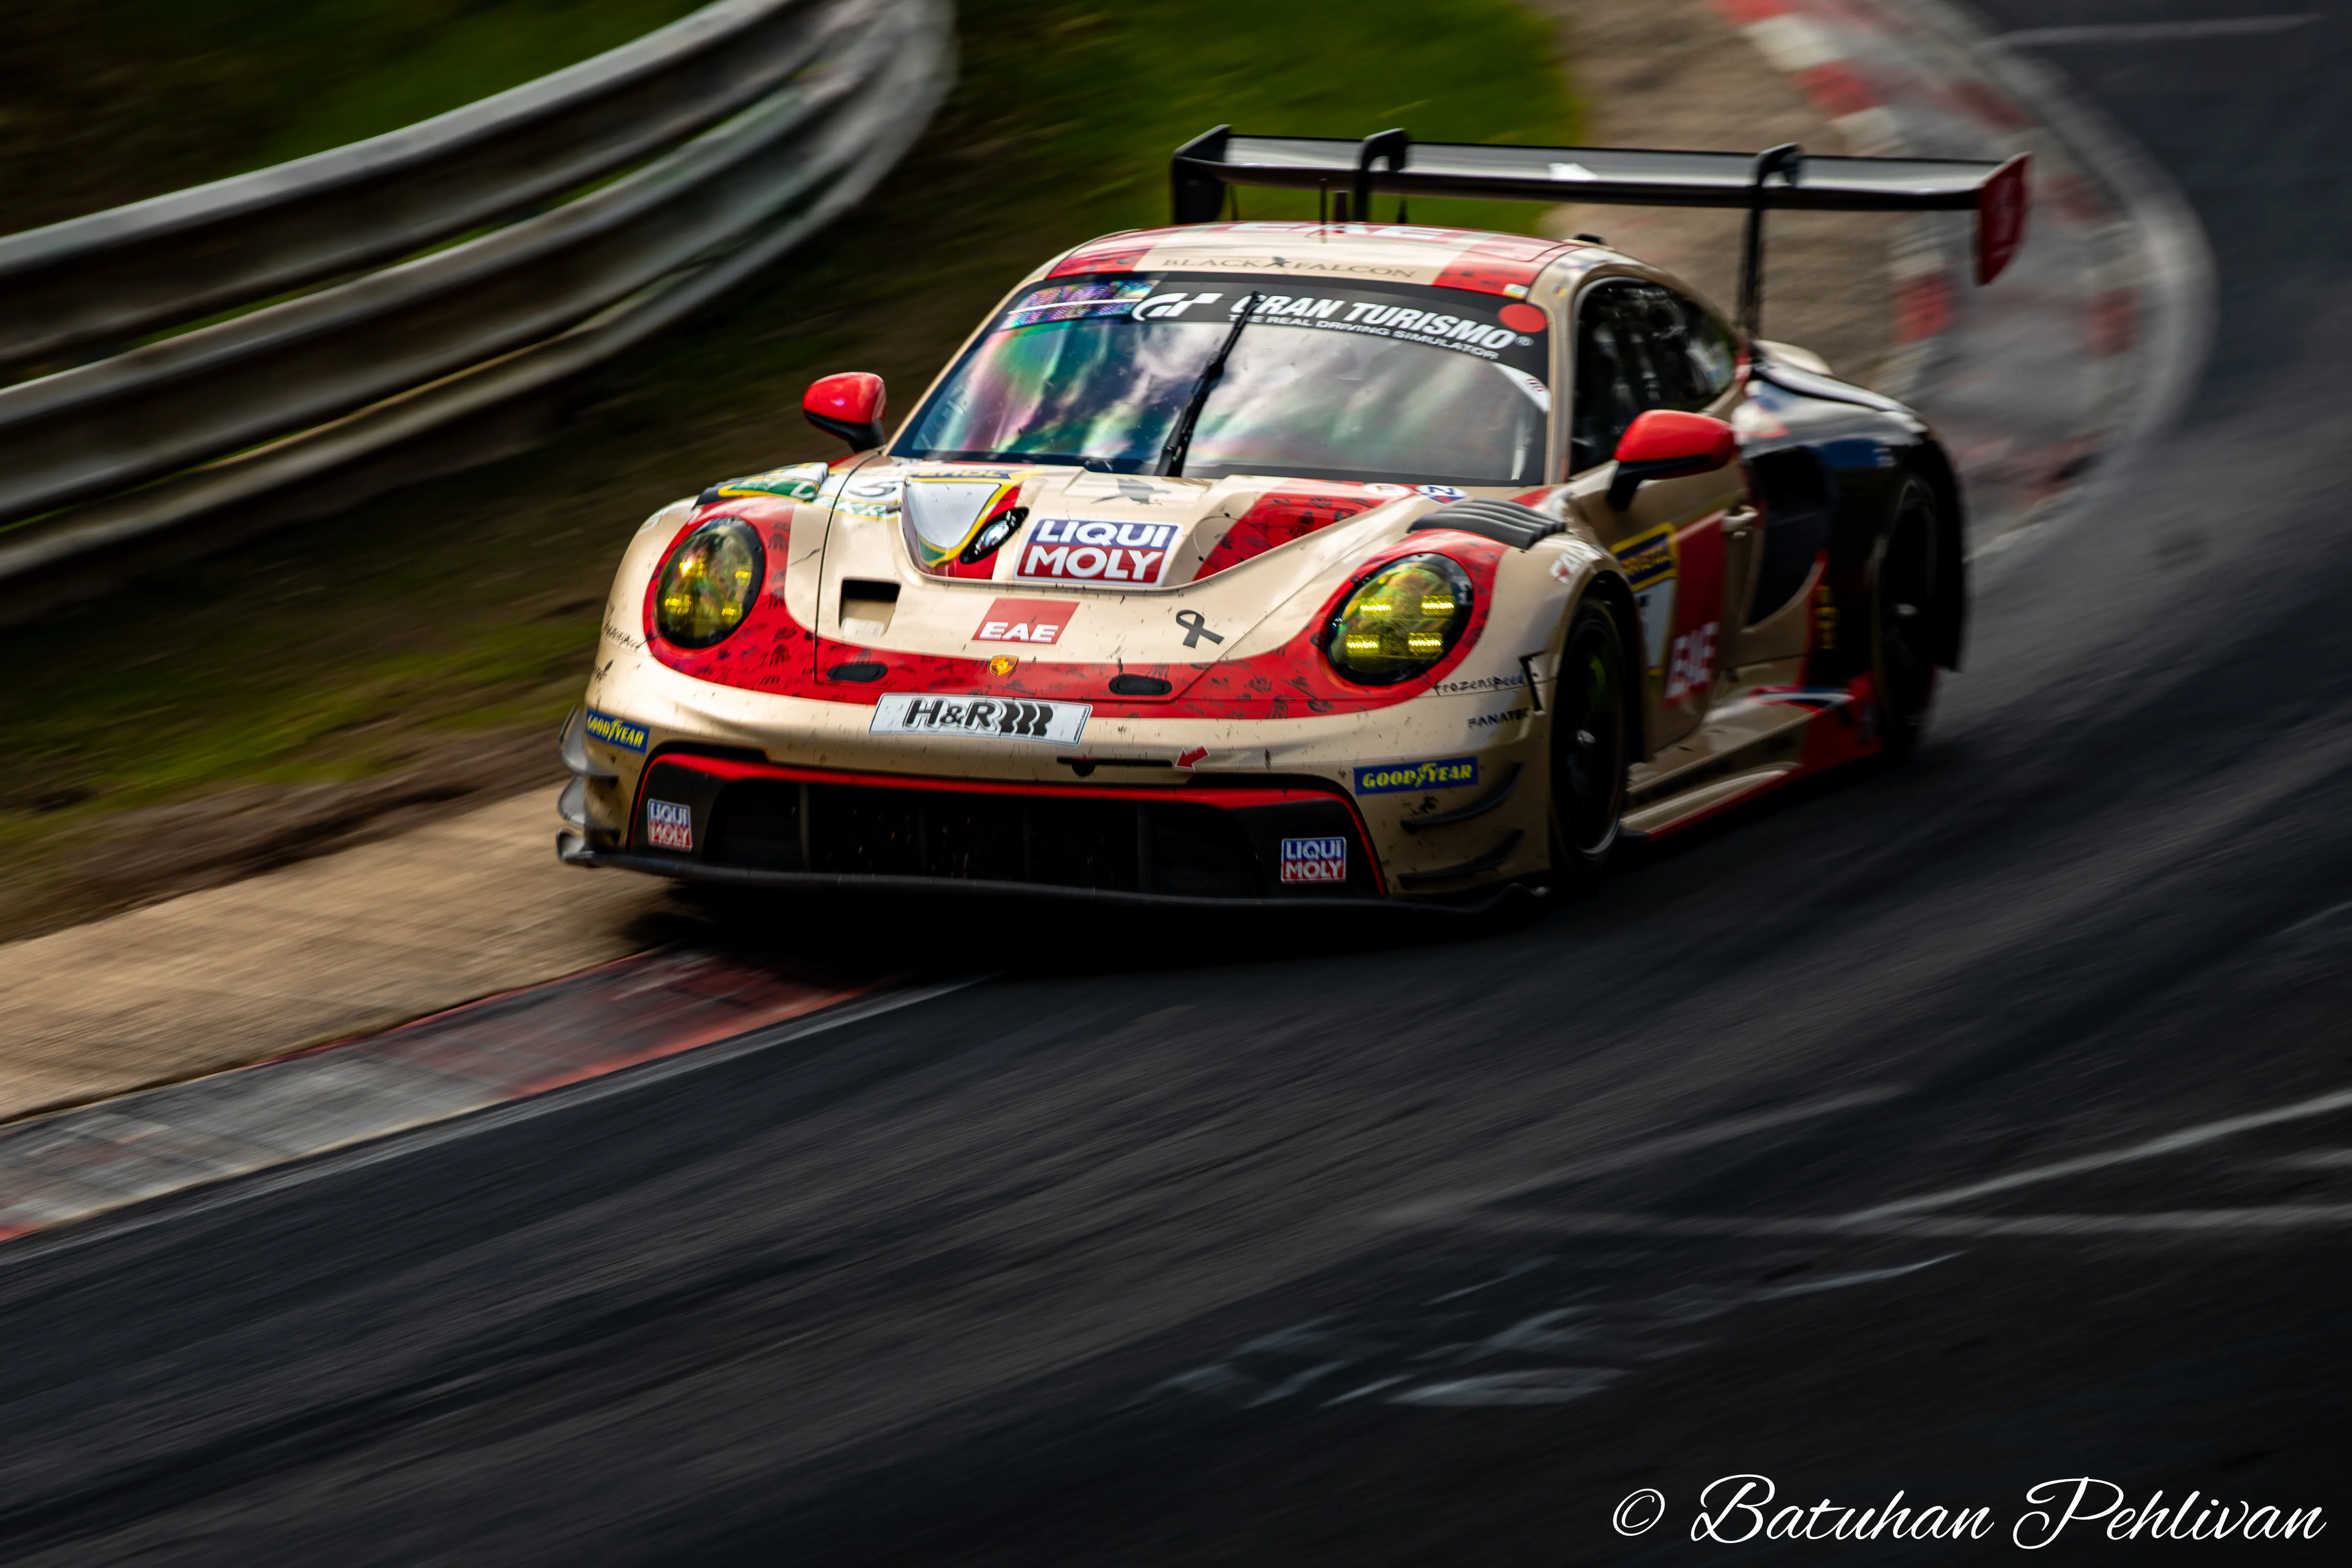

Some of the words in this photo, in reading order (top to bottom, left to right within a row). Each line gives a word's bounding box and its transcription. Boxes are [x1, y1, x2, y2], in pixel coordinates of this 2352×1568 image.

[1162, 258, 1260, 268] BLACK
[1292, 261, 1417, 278] FALCON
[1228, 314, 1265, 324] TE
[1266, 317, 1313, 327] REAL
[1315, 320, 1390, 337] DRIVING
[1392, 330, 1500, 360] SIMULATOR
[1035, 520, 1171, 548] LIQUI
[1024, 545, 1164, 580] MOLY
[979, 621, 1059, 643] EAE
[905, 698, 998, 732] H&R
[587, 714, 645, 748] GOODYEAR
[1362, 762, 1473, 788] GOODYEAR
[650, 802, 687, 826] LIQUI
[651, 820, 689, 848] MOLY
[1286, 839, 1341, 860] LIQUI
[1285, 860, 1342, 879] MOLY
